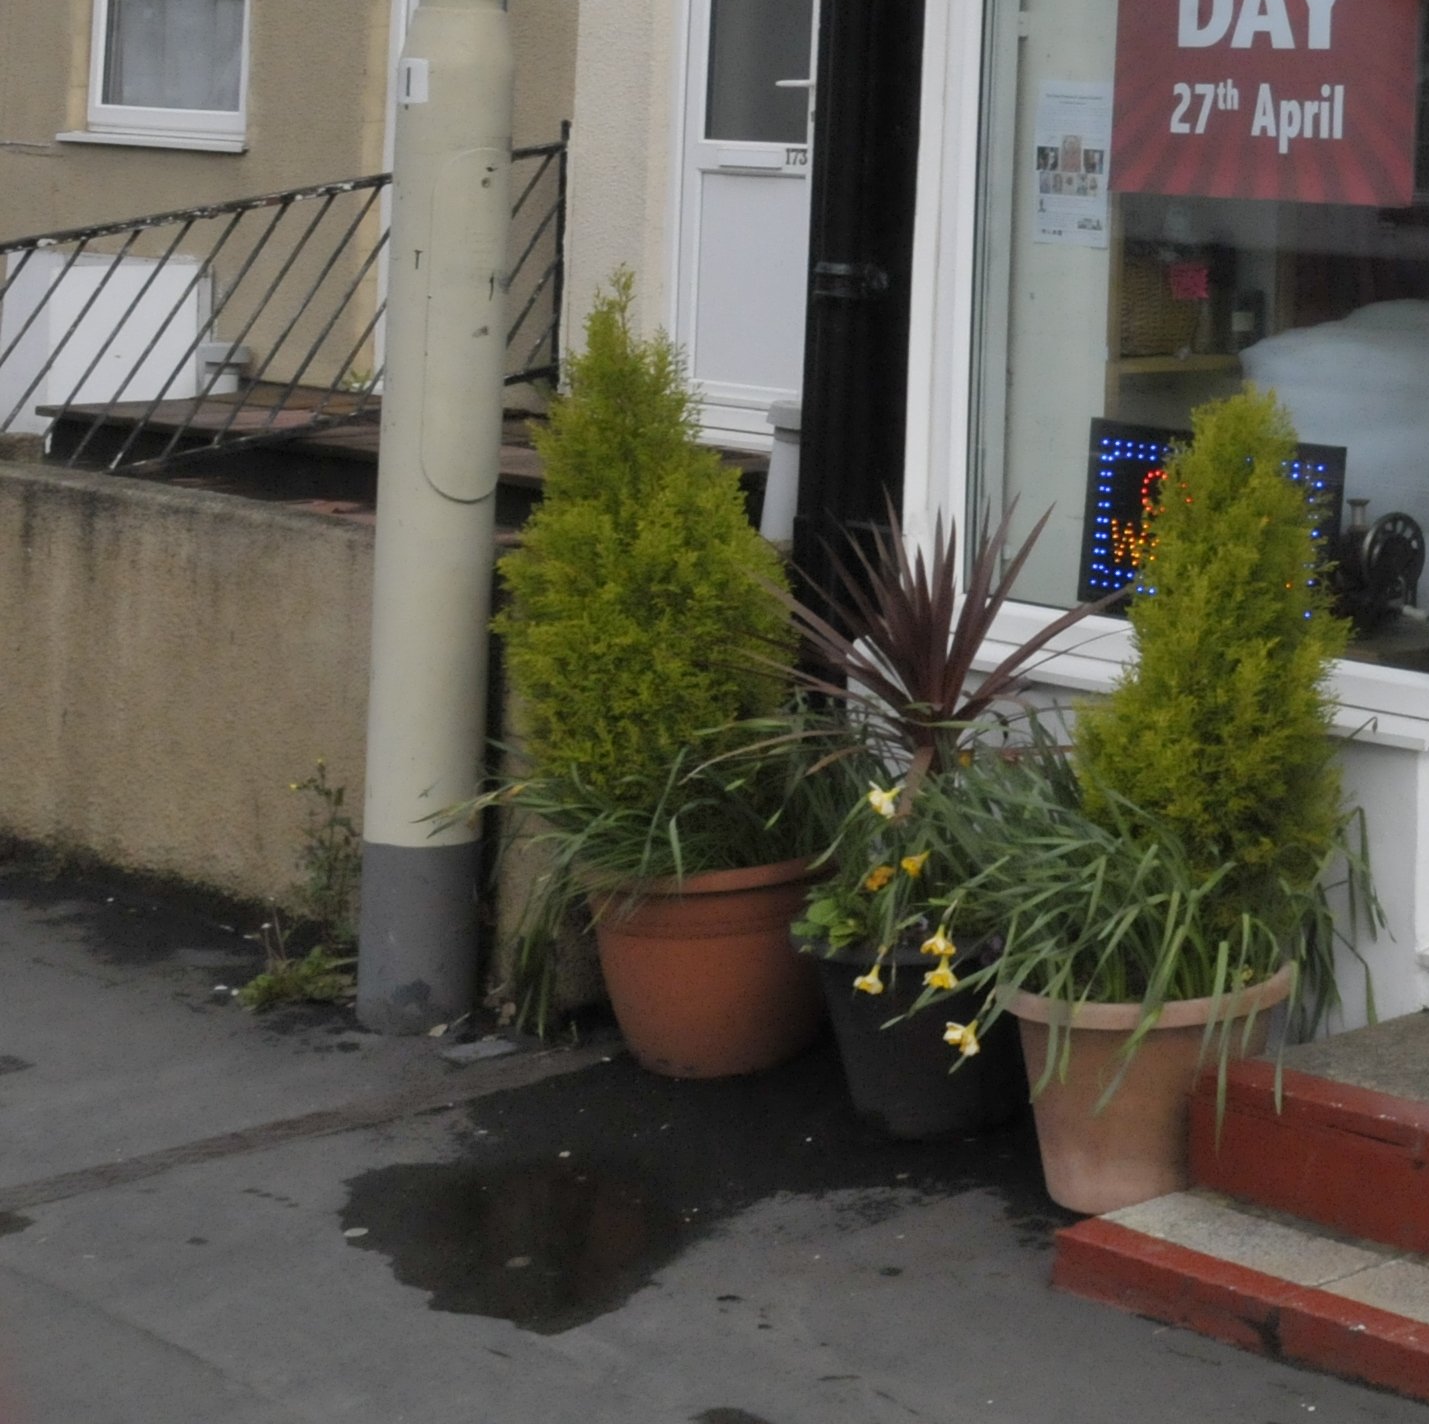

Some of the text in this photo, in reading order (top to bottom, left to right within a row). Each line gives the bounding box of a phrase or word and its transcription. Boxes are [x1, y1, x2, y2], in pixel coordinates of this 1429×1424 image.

[1170, 78, 1345, 154] 27th April
[785, 147, 808, 166] 173
